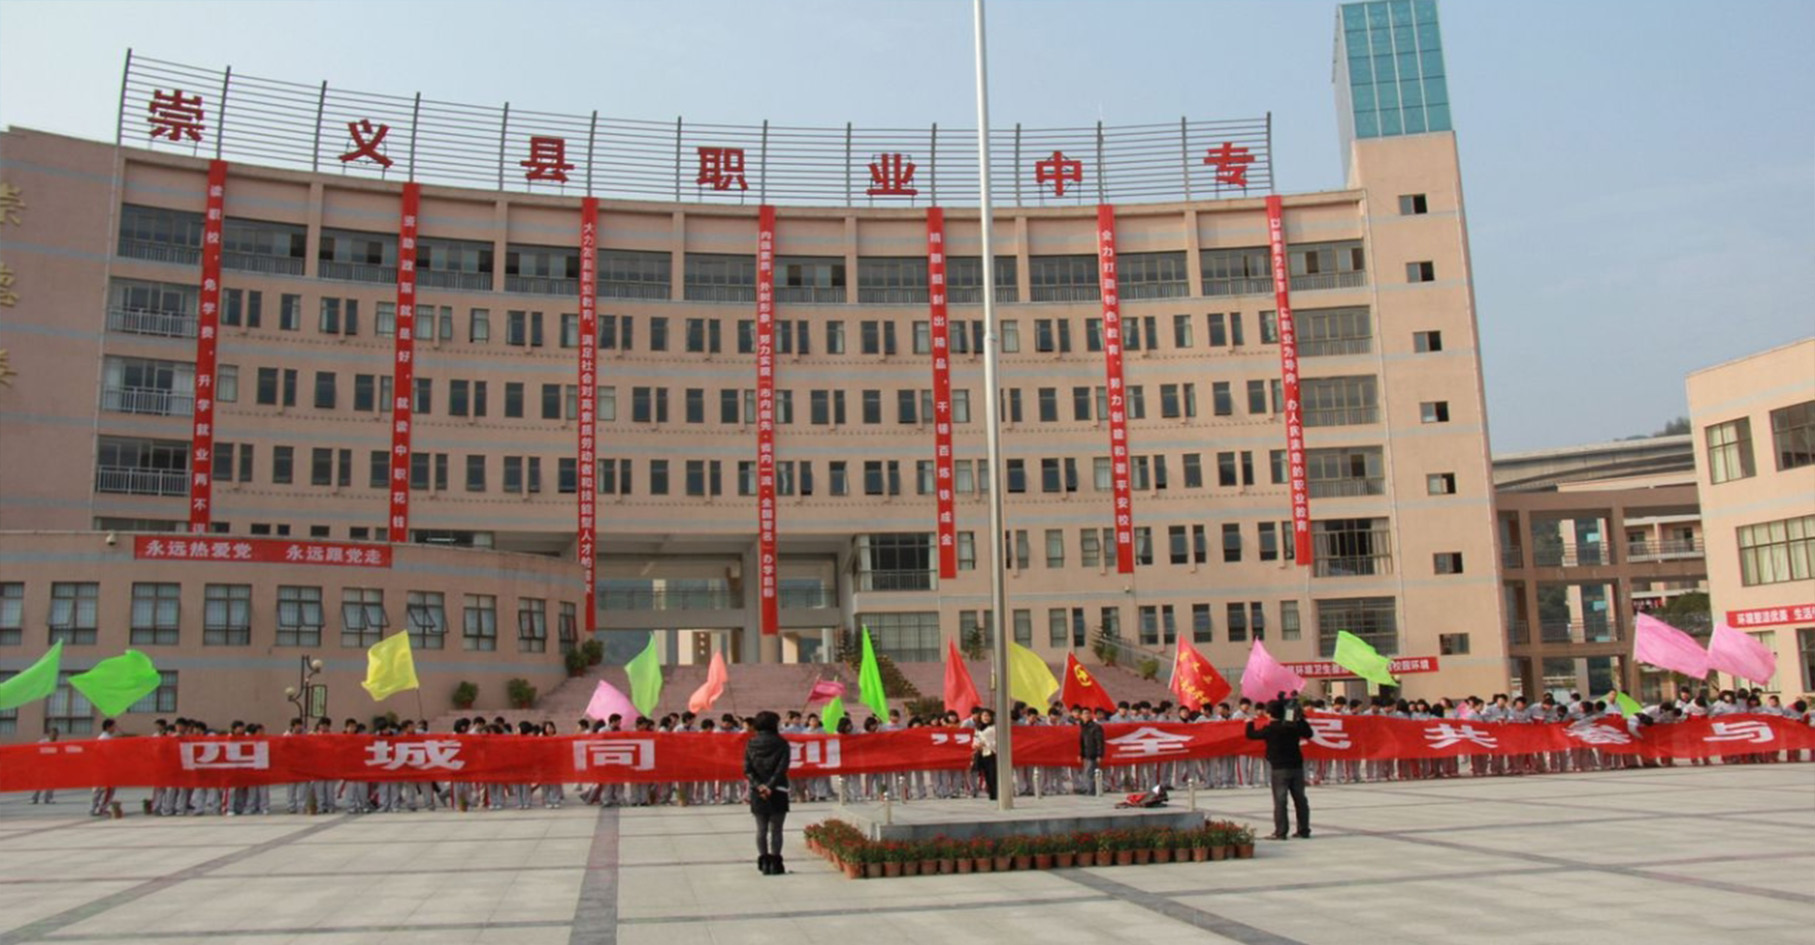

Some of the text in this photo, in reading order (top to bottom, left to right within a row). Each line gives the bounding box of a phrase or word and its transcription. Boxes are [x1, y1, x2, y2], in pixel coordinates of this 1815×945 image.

[147, 89, 1254, 196] 崇义县职业中专
[392, 215, 415, 542] 资助政策就是好，就读中职花钱
[146, 540, 382, 565] 永远热爱党 永远跟党走
[1794, 605, 1815, 620] 生活
